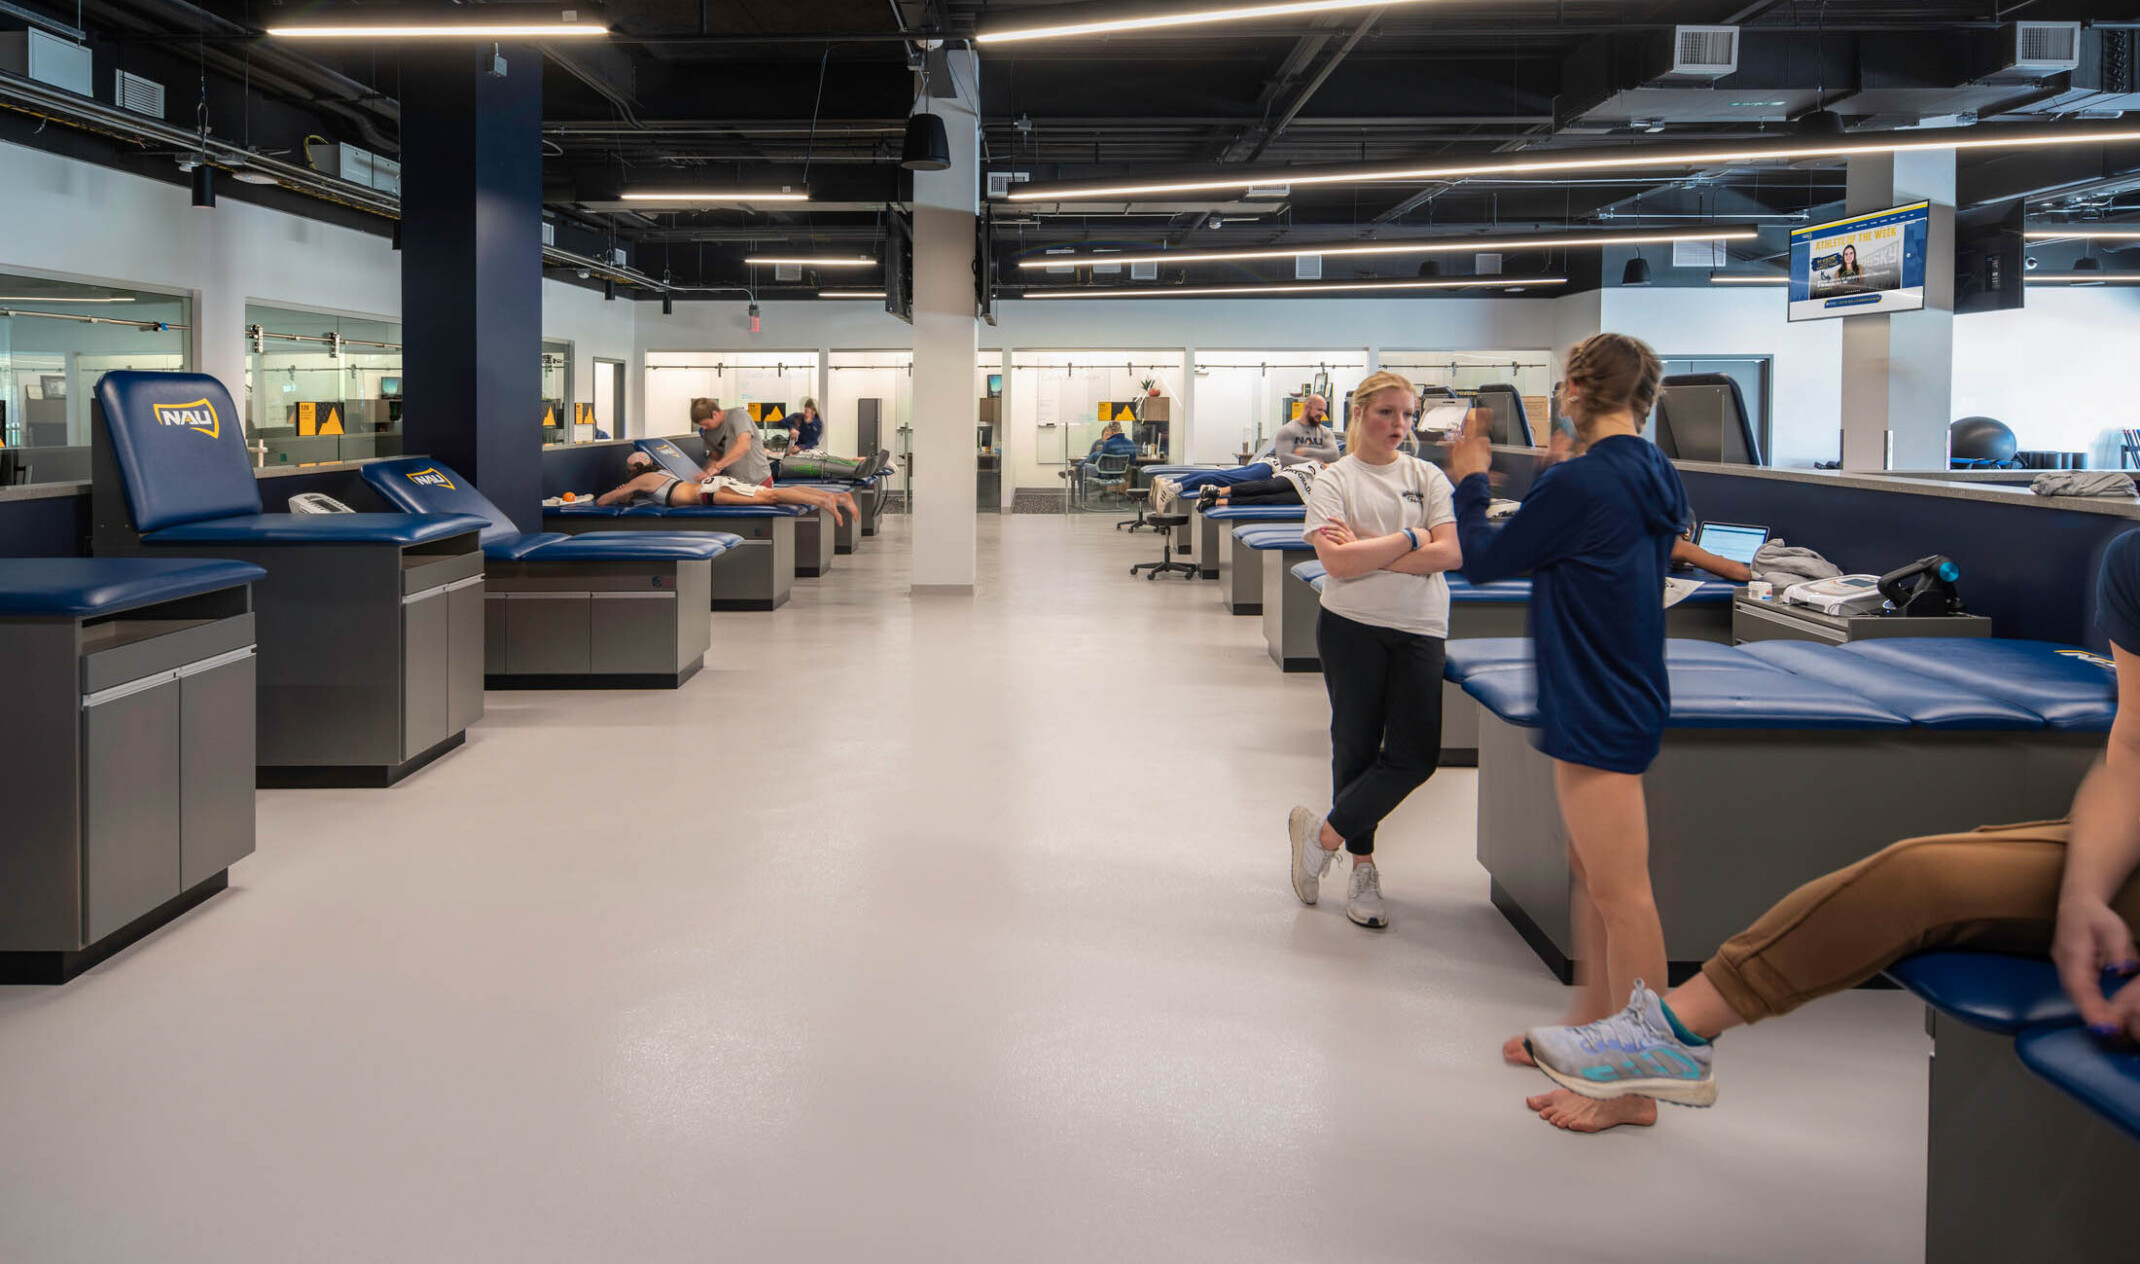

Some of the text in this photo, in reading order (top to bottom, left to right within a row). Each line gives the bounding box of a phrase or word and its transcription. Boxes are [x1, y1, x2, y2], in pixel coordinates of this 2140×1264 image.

[1858, 232, 1871, 242] THE
[1874, 227, 1897, 239] WEEK
[161, 410, 212, 426] NAU
[1294, 436, 1323, 446] NAU
[414, 474, 446, 485] NAU
